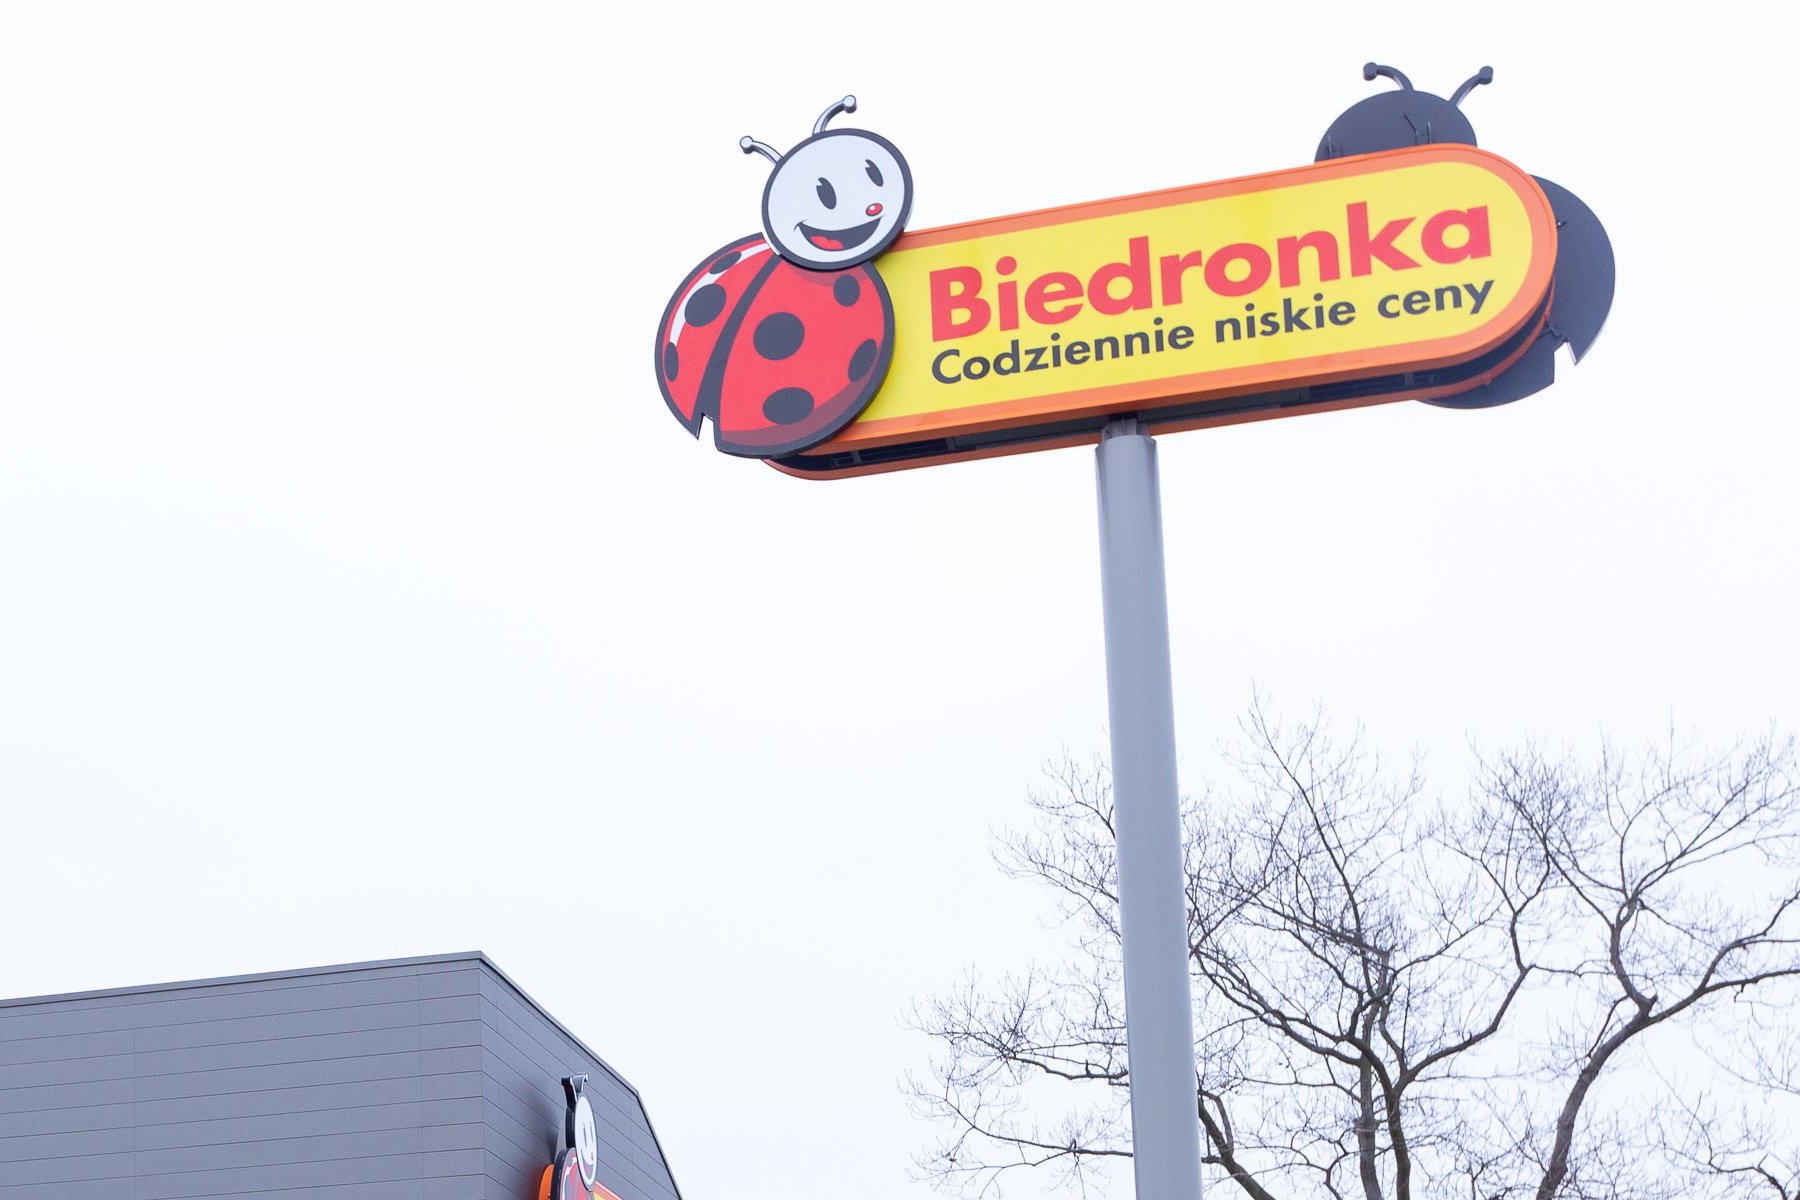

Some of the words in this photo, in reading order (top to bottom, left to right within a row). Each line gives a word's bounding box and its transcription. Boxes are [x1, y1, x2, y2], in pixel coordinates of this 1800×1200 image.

[929, 201, 1492, 342] Biedronka
[931, 317, 1194, 384] Codziennie
[1215, 293, 1356, 343] niskie
[1377, 280, 1495, 320] ceny
